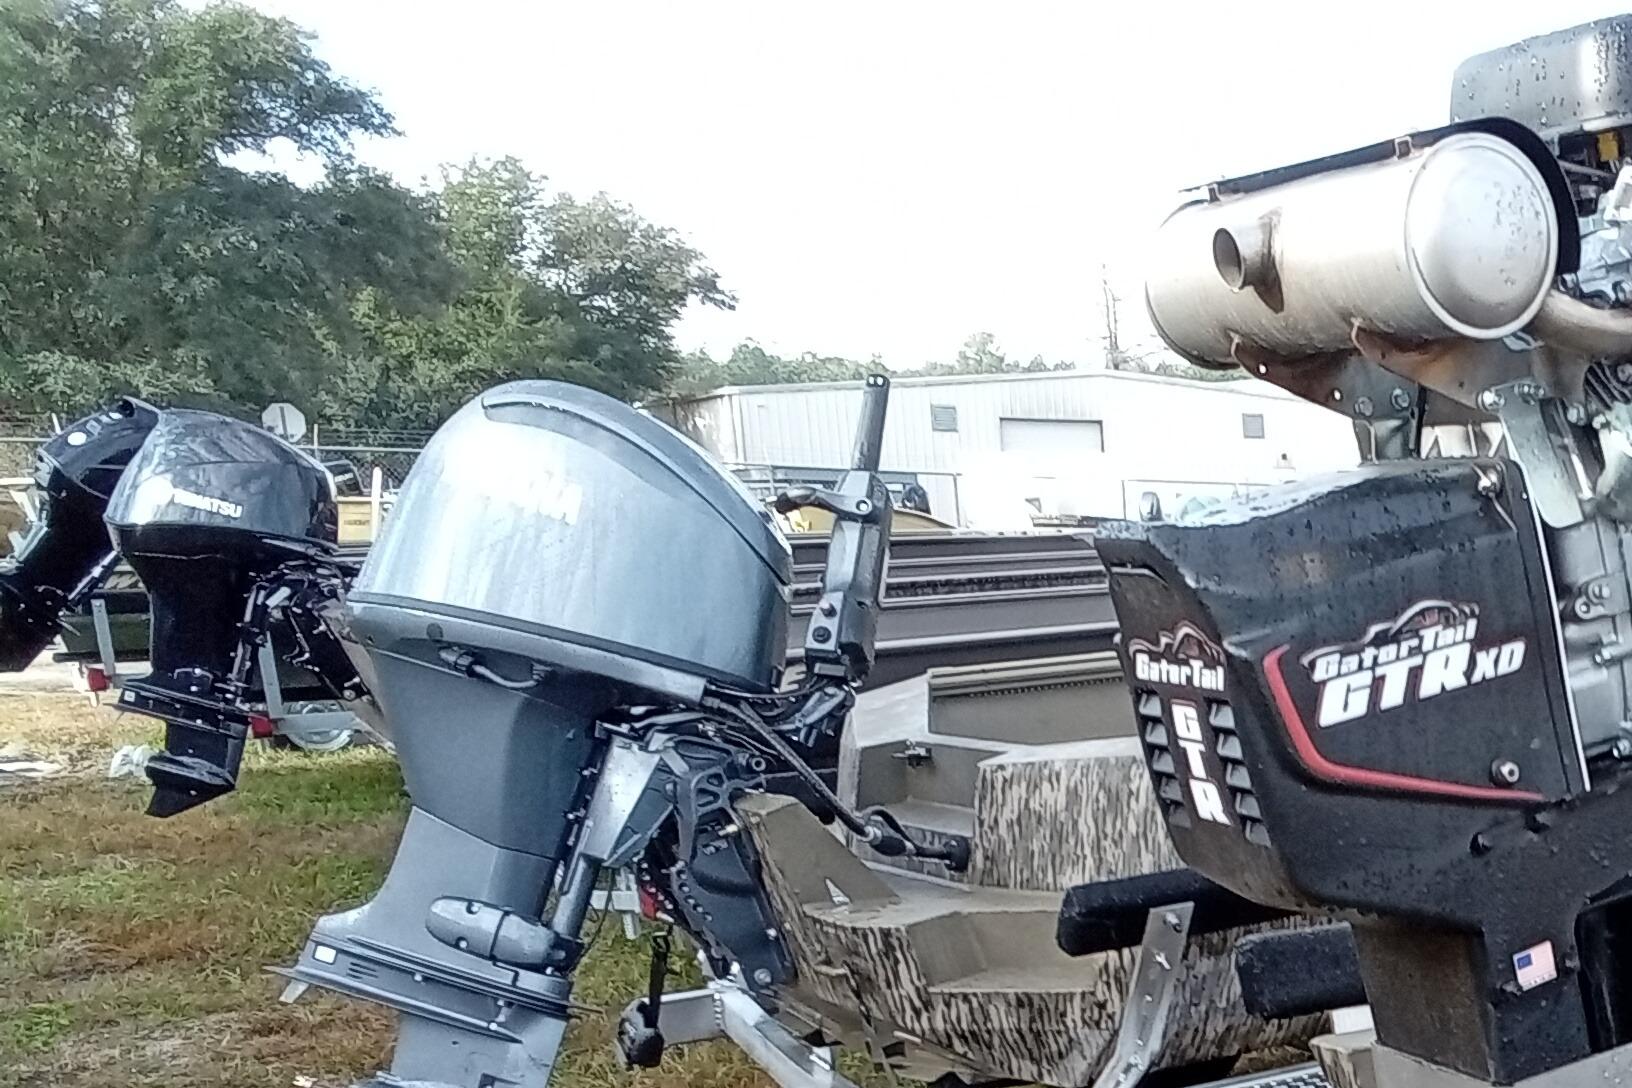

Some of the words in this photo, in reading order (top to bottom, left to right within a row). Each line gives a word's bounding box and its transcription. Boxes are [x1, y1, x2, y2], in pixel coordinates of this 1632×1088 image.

[174, 488, 243, 519] ATSU
[1135, 652, 1225, 692] GatorTail
[1312, 617, 1478, 684] GatorTail
[1318, 642, 1471, 729] GTR
[1171, 703, 1232, 826] GTR
